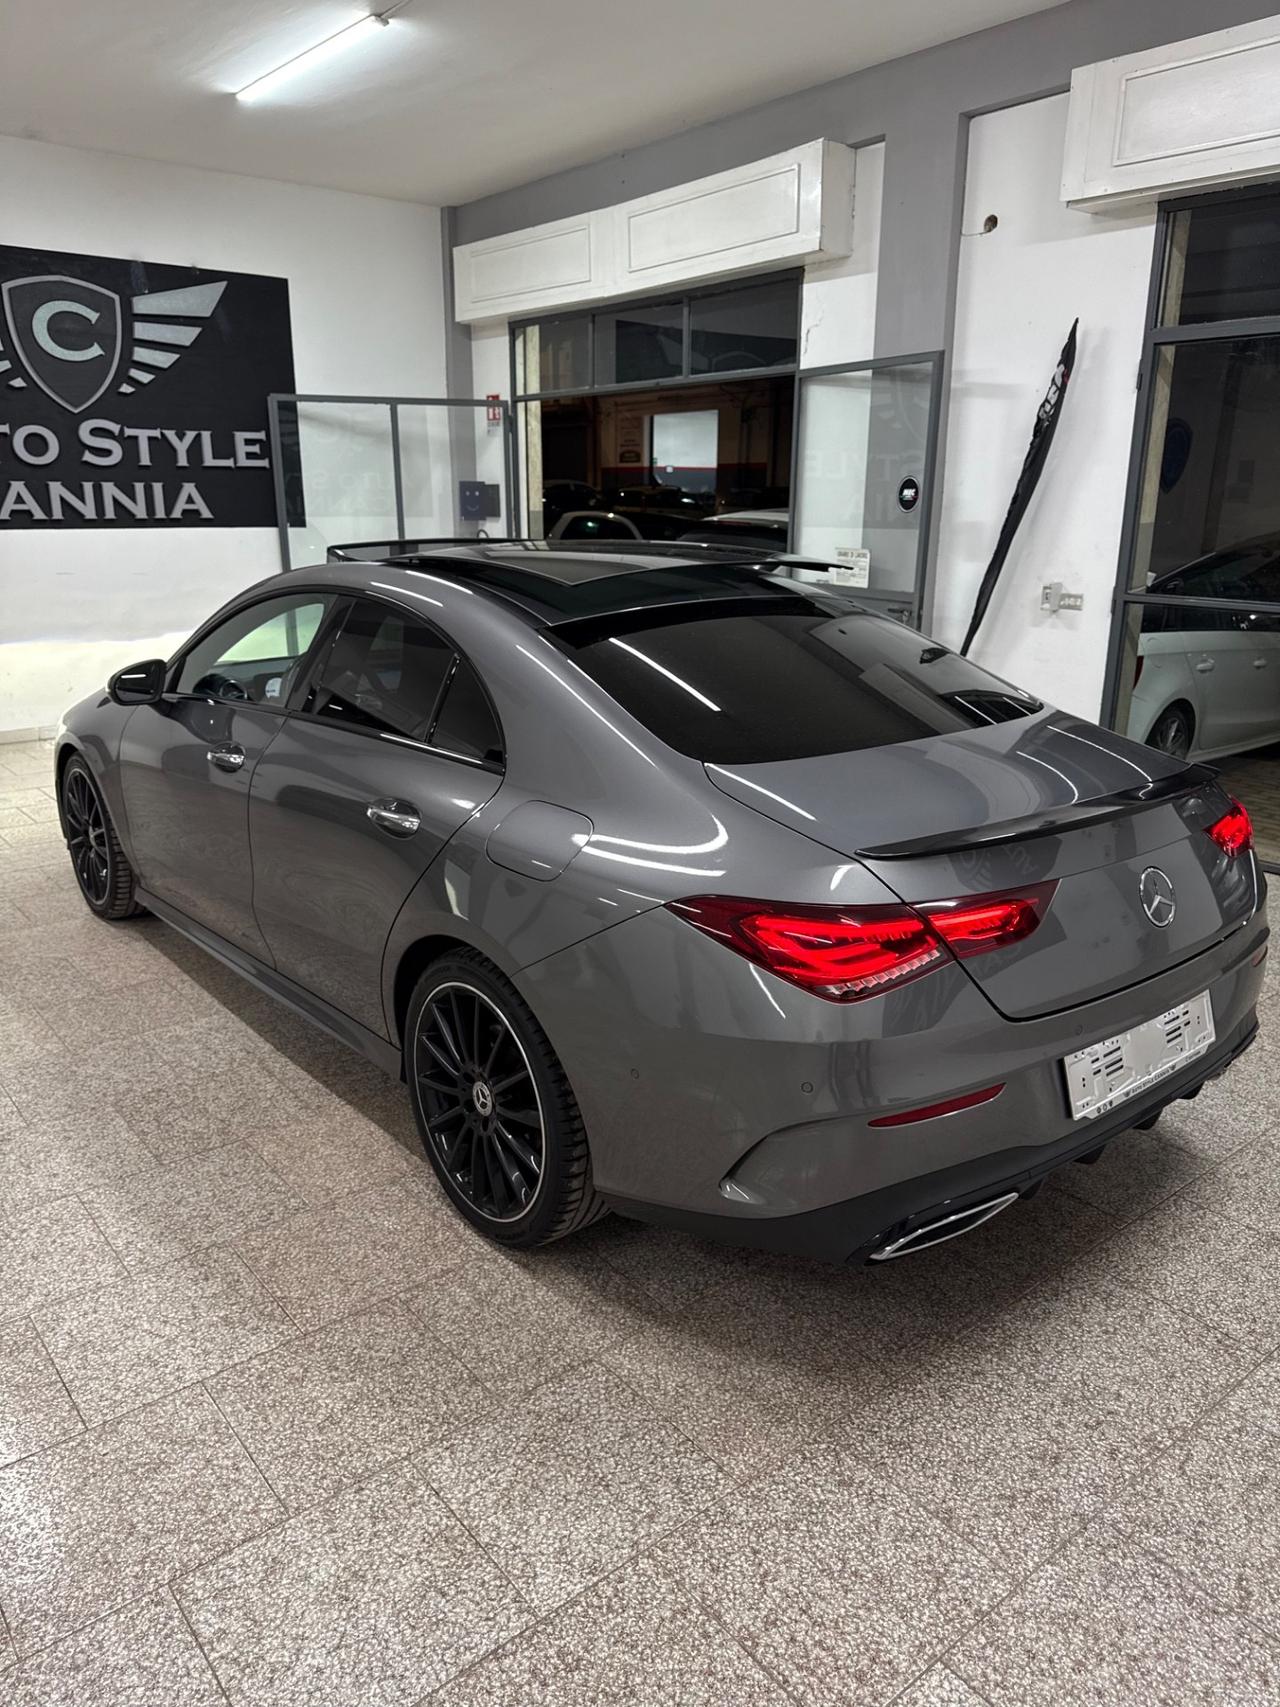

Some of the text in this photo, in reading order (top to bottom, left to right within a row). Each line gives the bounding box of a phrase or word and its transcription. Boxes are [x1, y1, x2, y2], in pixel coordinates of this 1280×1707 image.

[32, 300, 105, 361] C
[0, 418, 270, 469] O STYLE
